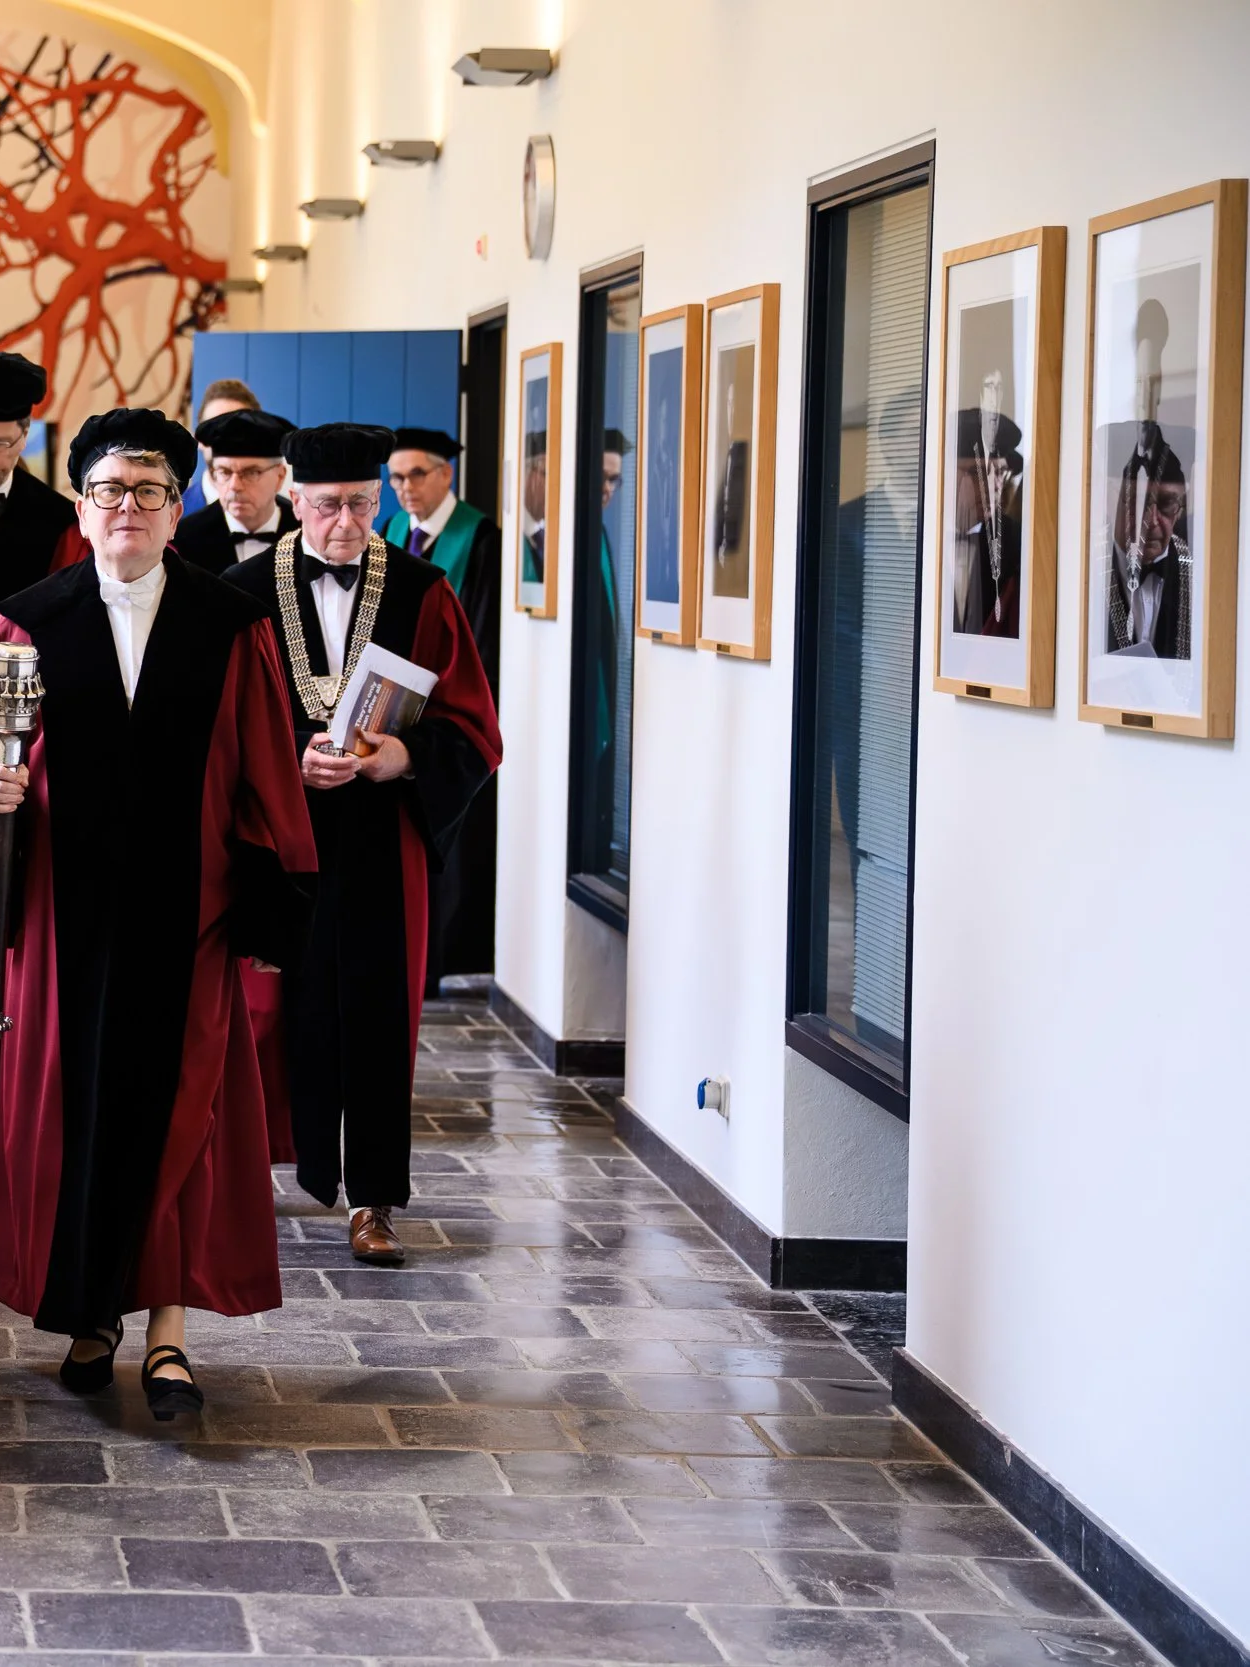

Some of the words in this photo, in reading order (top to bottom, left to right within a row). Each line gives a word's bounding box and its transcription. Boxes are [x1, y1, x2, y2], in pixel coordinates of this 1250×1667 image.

[355, 699, 369, 727] They're
[367, 681, 377, 698] only
[367, 694, 377, 713] after
